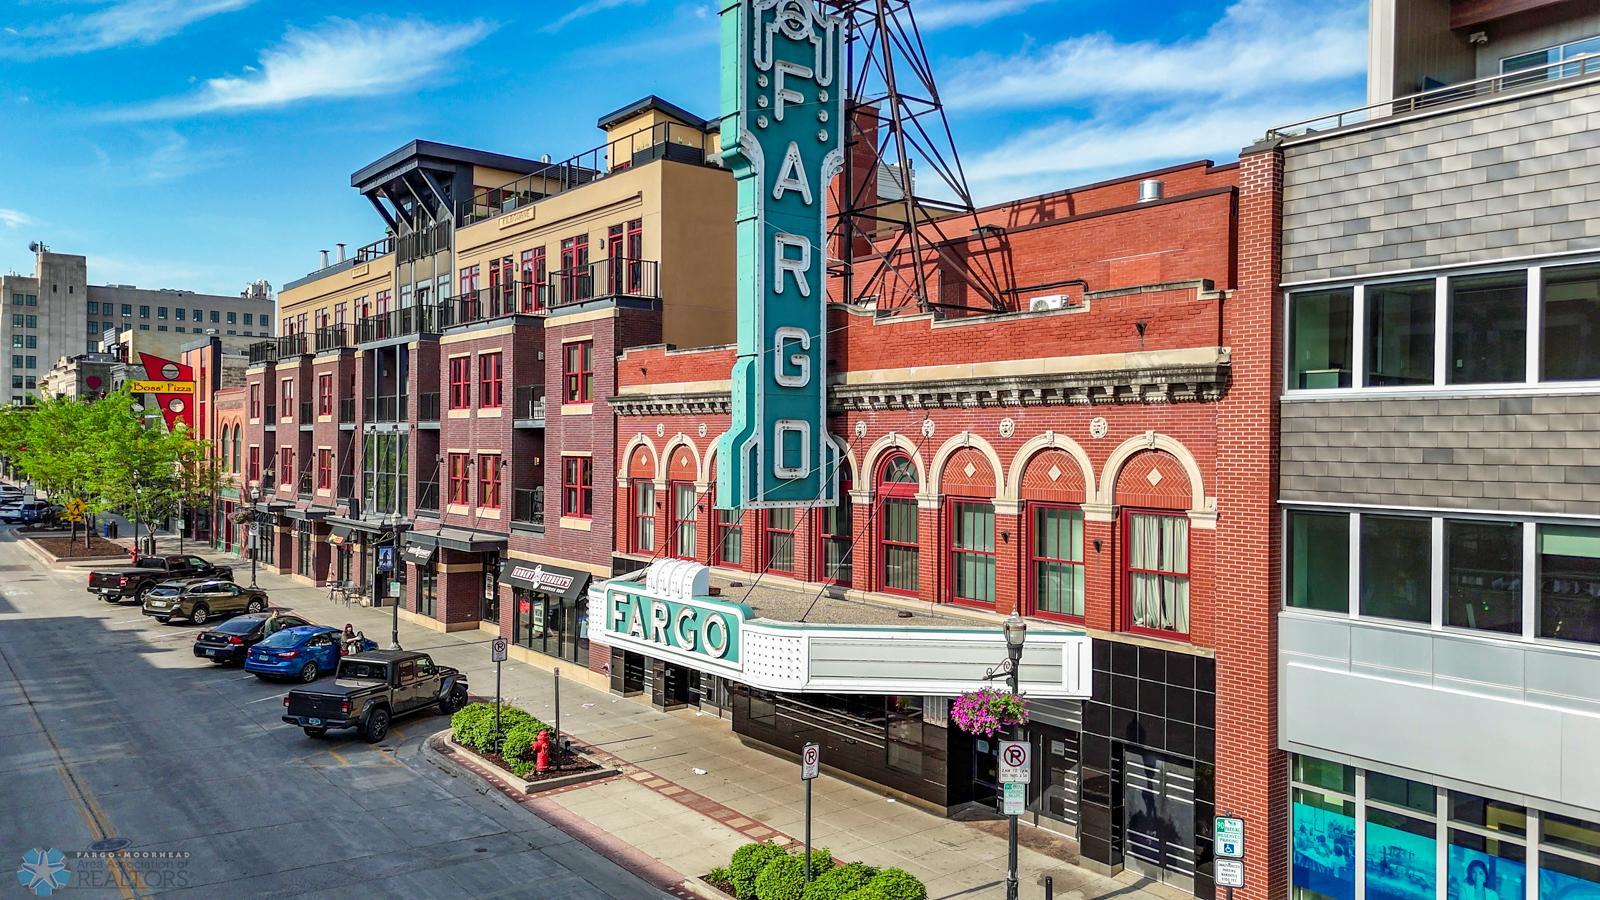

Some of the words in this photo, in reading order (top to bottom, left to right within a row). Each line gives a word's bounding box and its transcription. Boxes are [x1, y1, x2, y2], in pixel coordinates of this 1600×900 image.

[772, 59, 814, 480] FARGO
[133, 382, 164, 392] Boss'
[167, 383, 192, 392] Pizza
[612, 592, 730, 659] FARGO
